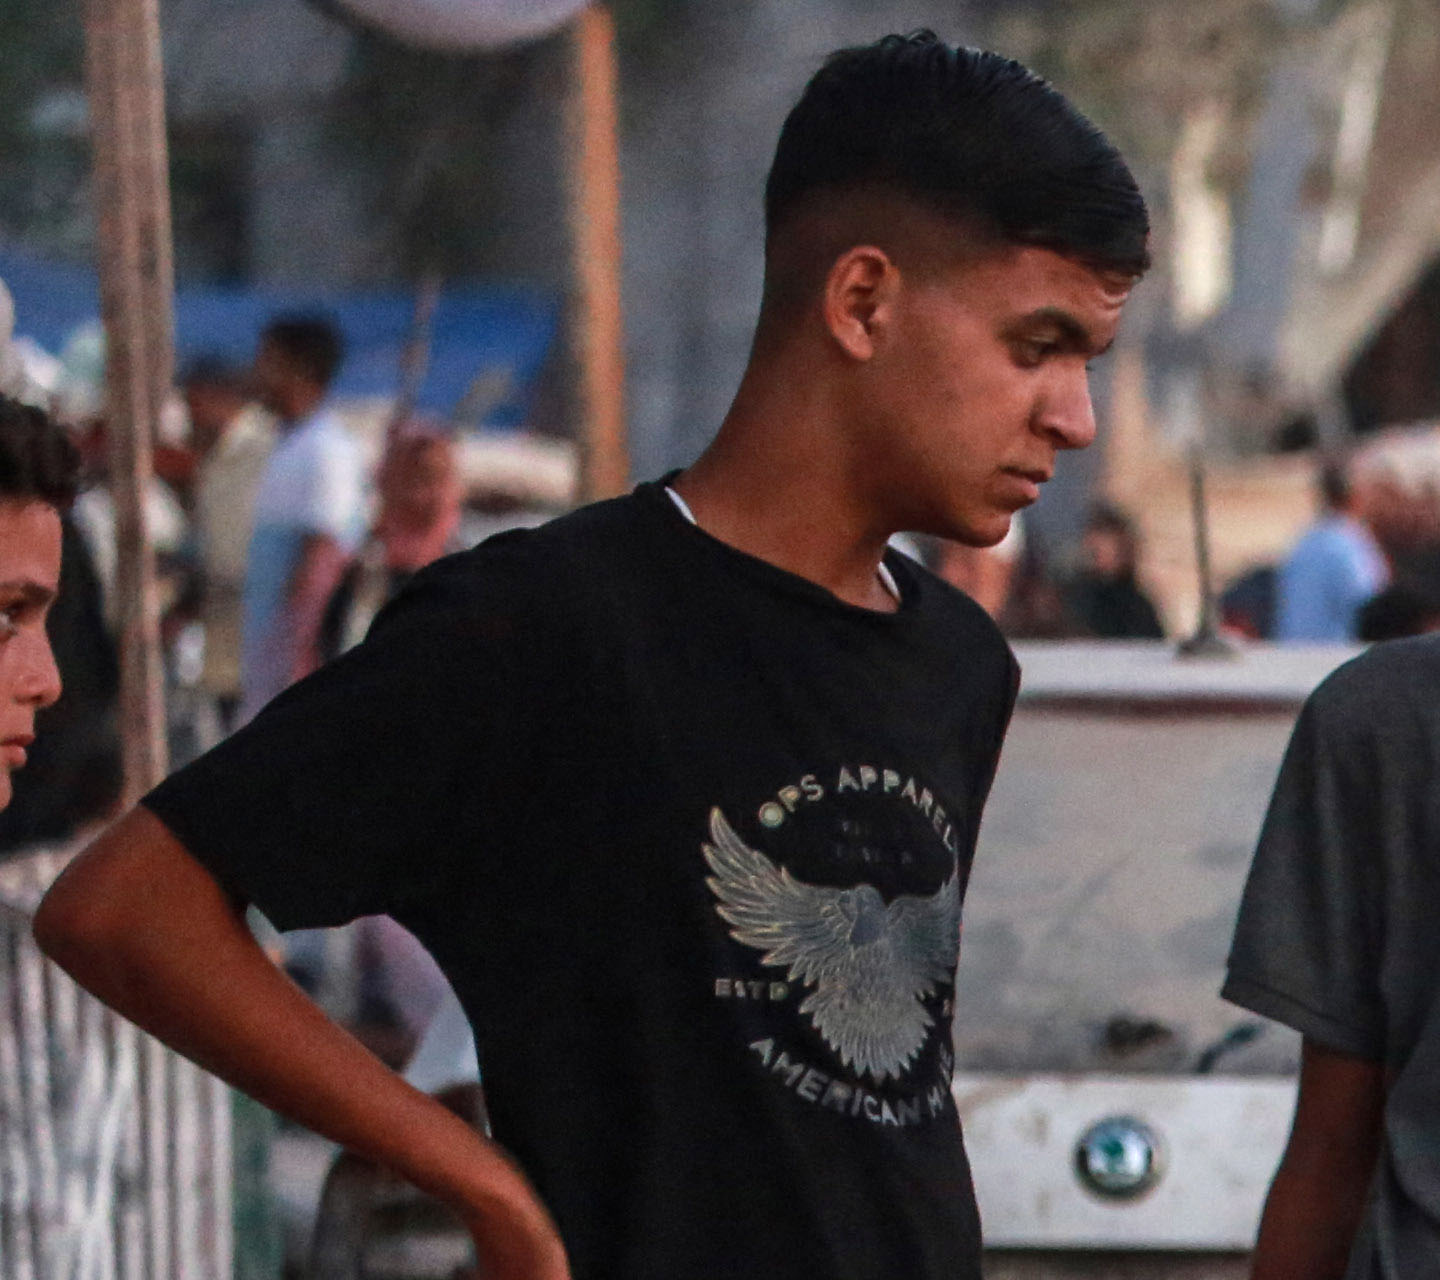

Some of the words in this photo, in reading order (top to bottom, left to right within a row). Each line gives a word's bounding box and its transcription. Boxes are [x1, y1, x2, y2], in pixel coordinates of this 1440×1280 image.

[758, 773, 824, 829] OPS
[837, 765, 955, 852] APPAREL
[749, 1036, 922, 1127] AMERICAN
